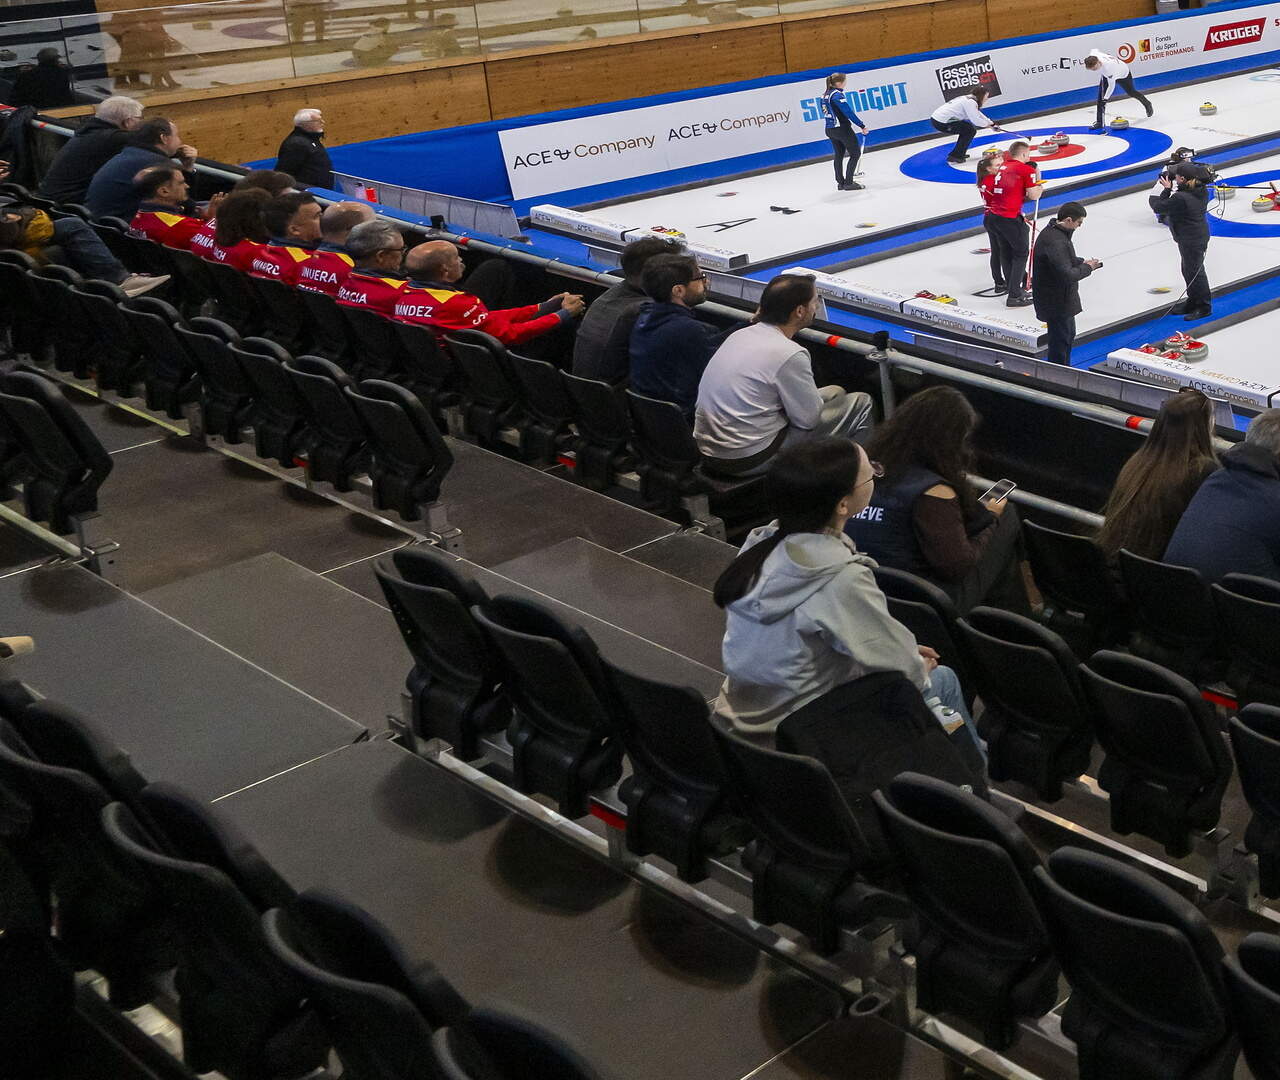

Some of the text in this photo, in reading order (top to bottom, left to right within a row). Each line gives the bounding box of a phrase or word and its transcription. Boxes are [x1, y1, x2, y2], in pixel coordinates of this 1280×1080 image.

[1155, 34, 1171, 43] Fonds
[1164, 41, 1179, 51] Sport
[1139, 46, 1196, 63] LOTERIE ROMANDE
[941, 59, 994, 82] fassbind
[1021, 64, 1058, 76] WEBER
[667, 123, 702, 142] ACE
[719, 109, 792, 132] Company
[513, 149, 553, 171] ACE
[573, 133, 656, 159] Company
[695, 217, 758, 233] A
